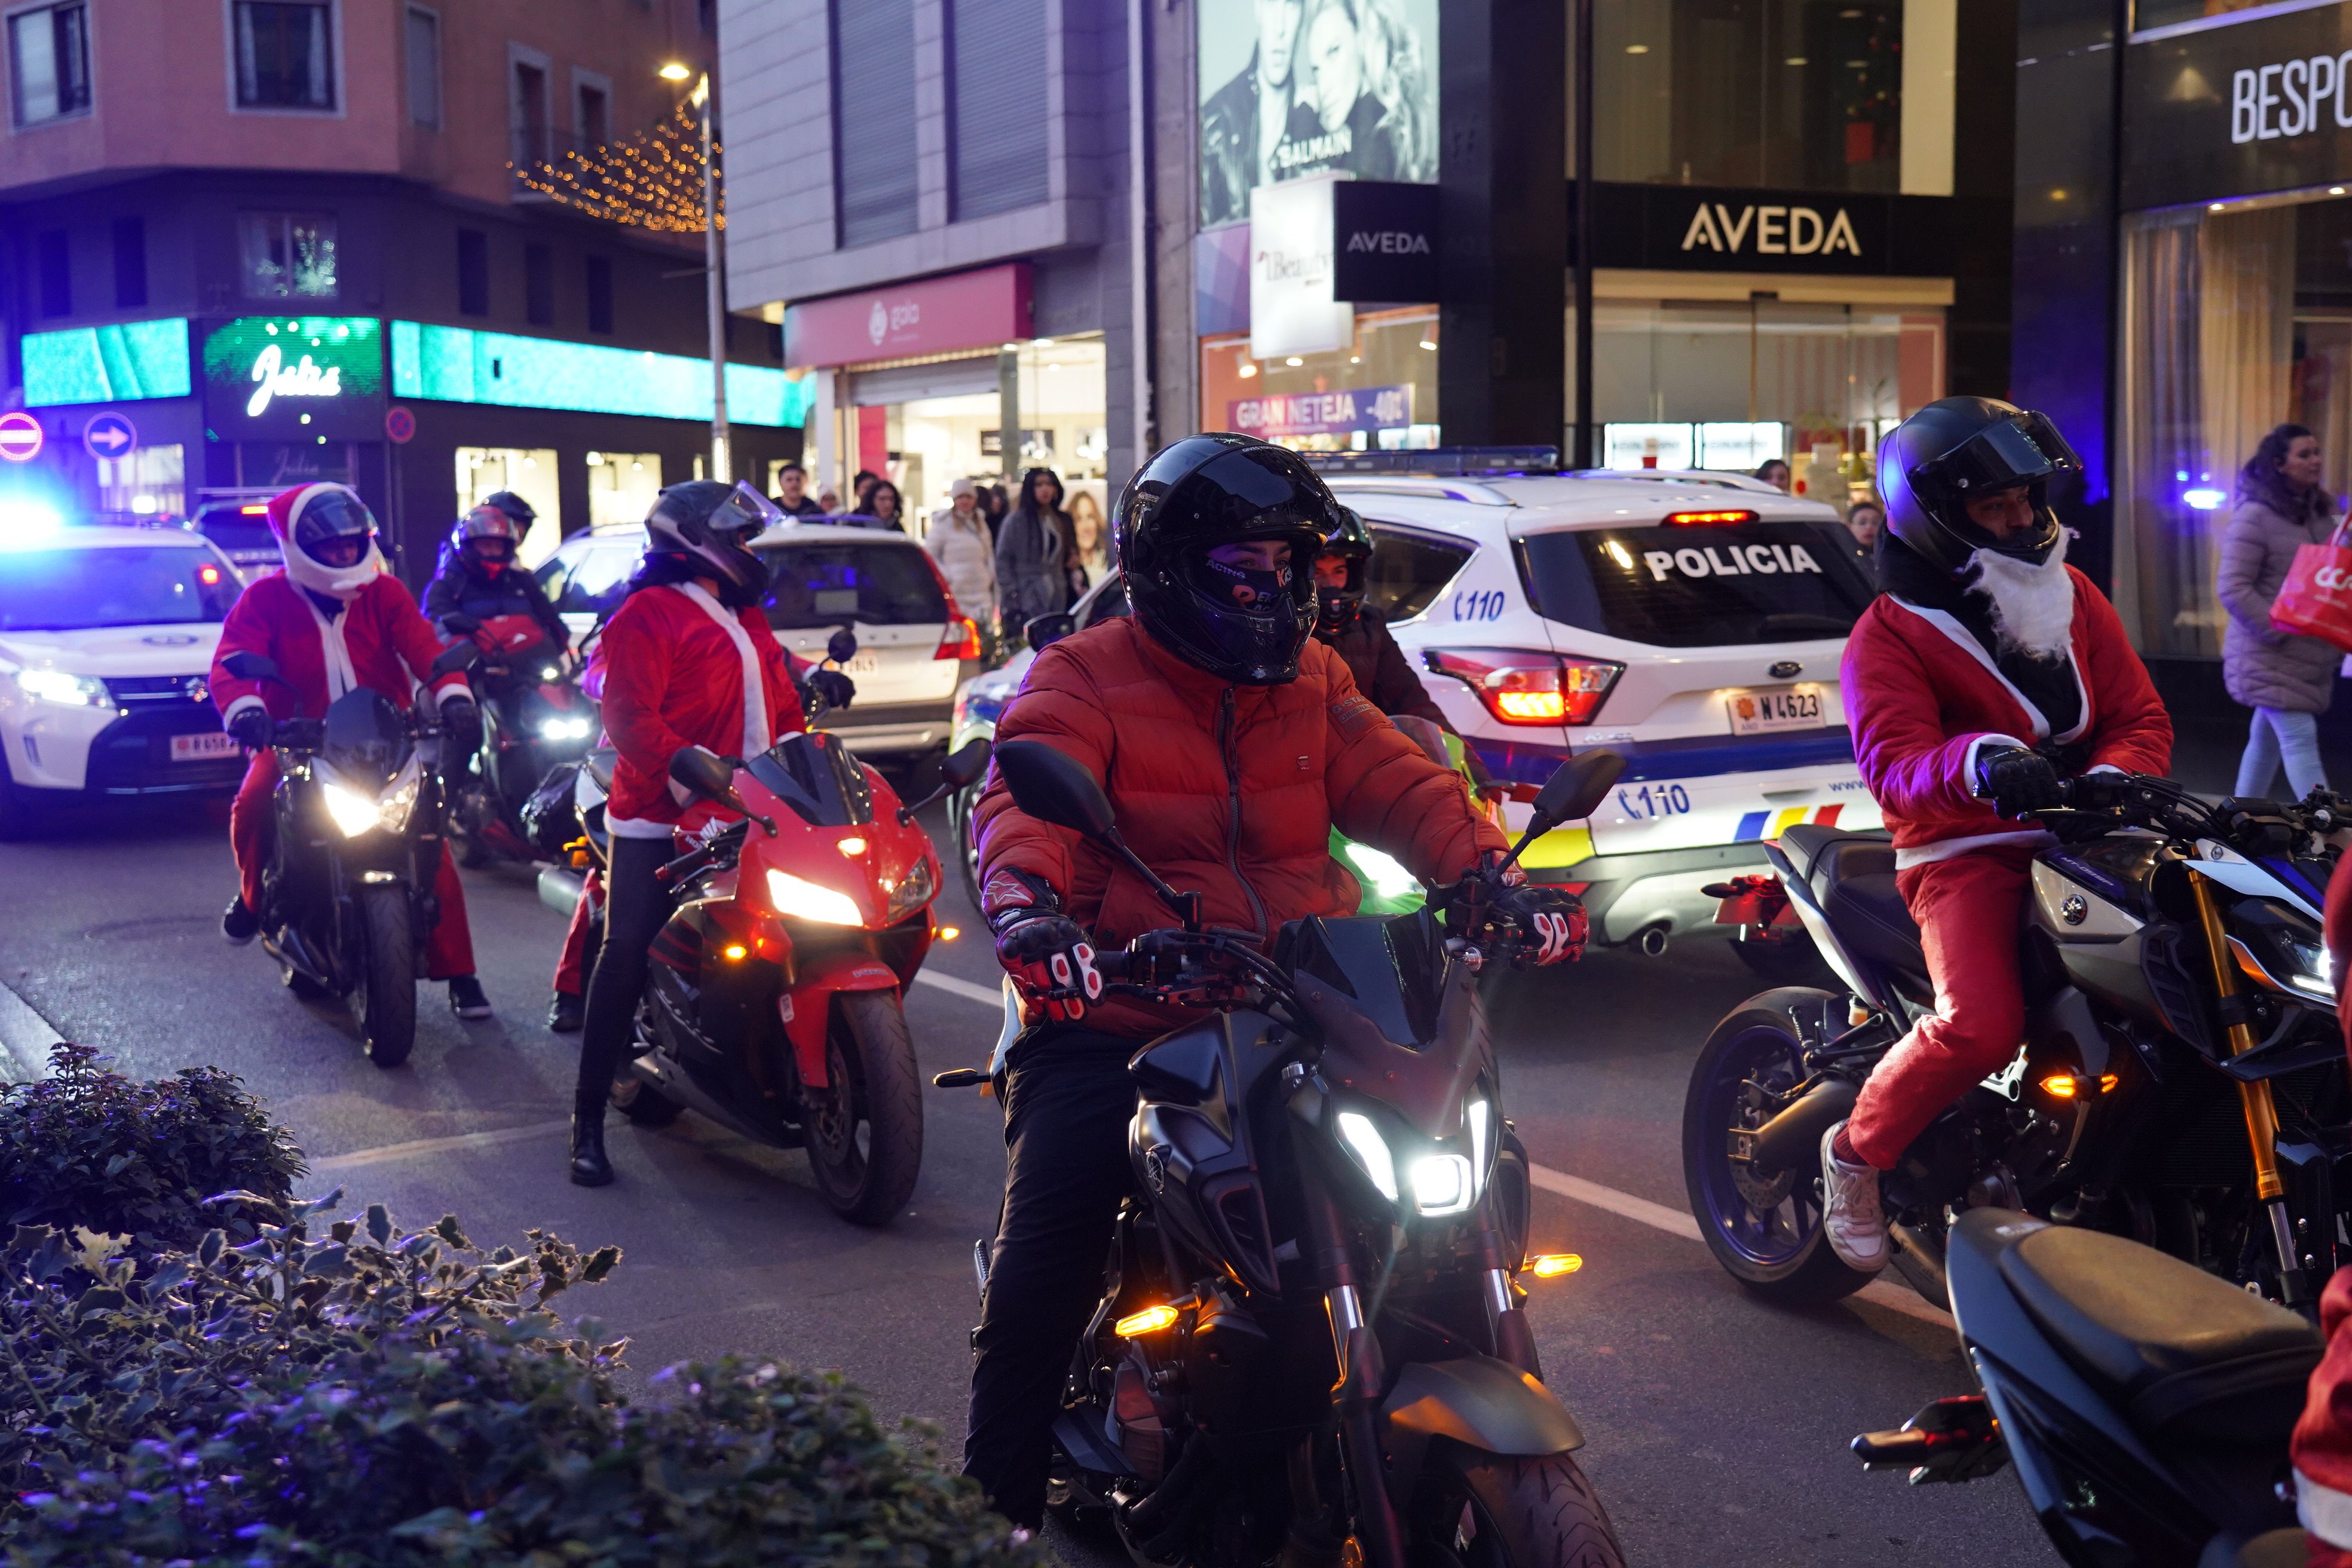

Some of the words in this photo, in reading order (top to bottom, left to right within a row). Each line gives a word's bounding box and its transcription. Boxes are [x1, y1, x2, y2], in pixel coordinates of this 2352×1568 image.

[1347, 231, 1431, 255] AVEDA
[1681, 202, 1863, 256] AVEDA
[1236, 399, 1285, 429] GRAN
[1287, 393, 1356, 425] NETEJA
[1643, 544, 1823, 582] POLICIA
[1466, 590, 1505, 622] 110
[1638, 784, 1690, 816] 110
